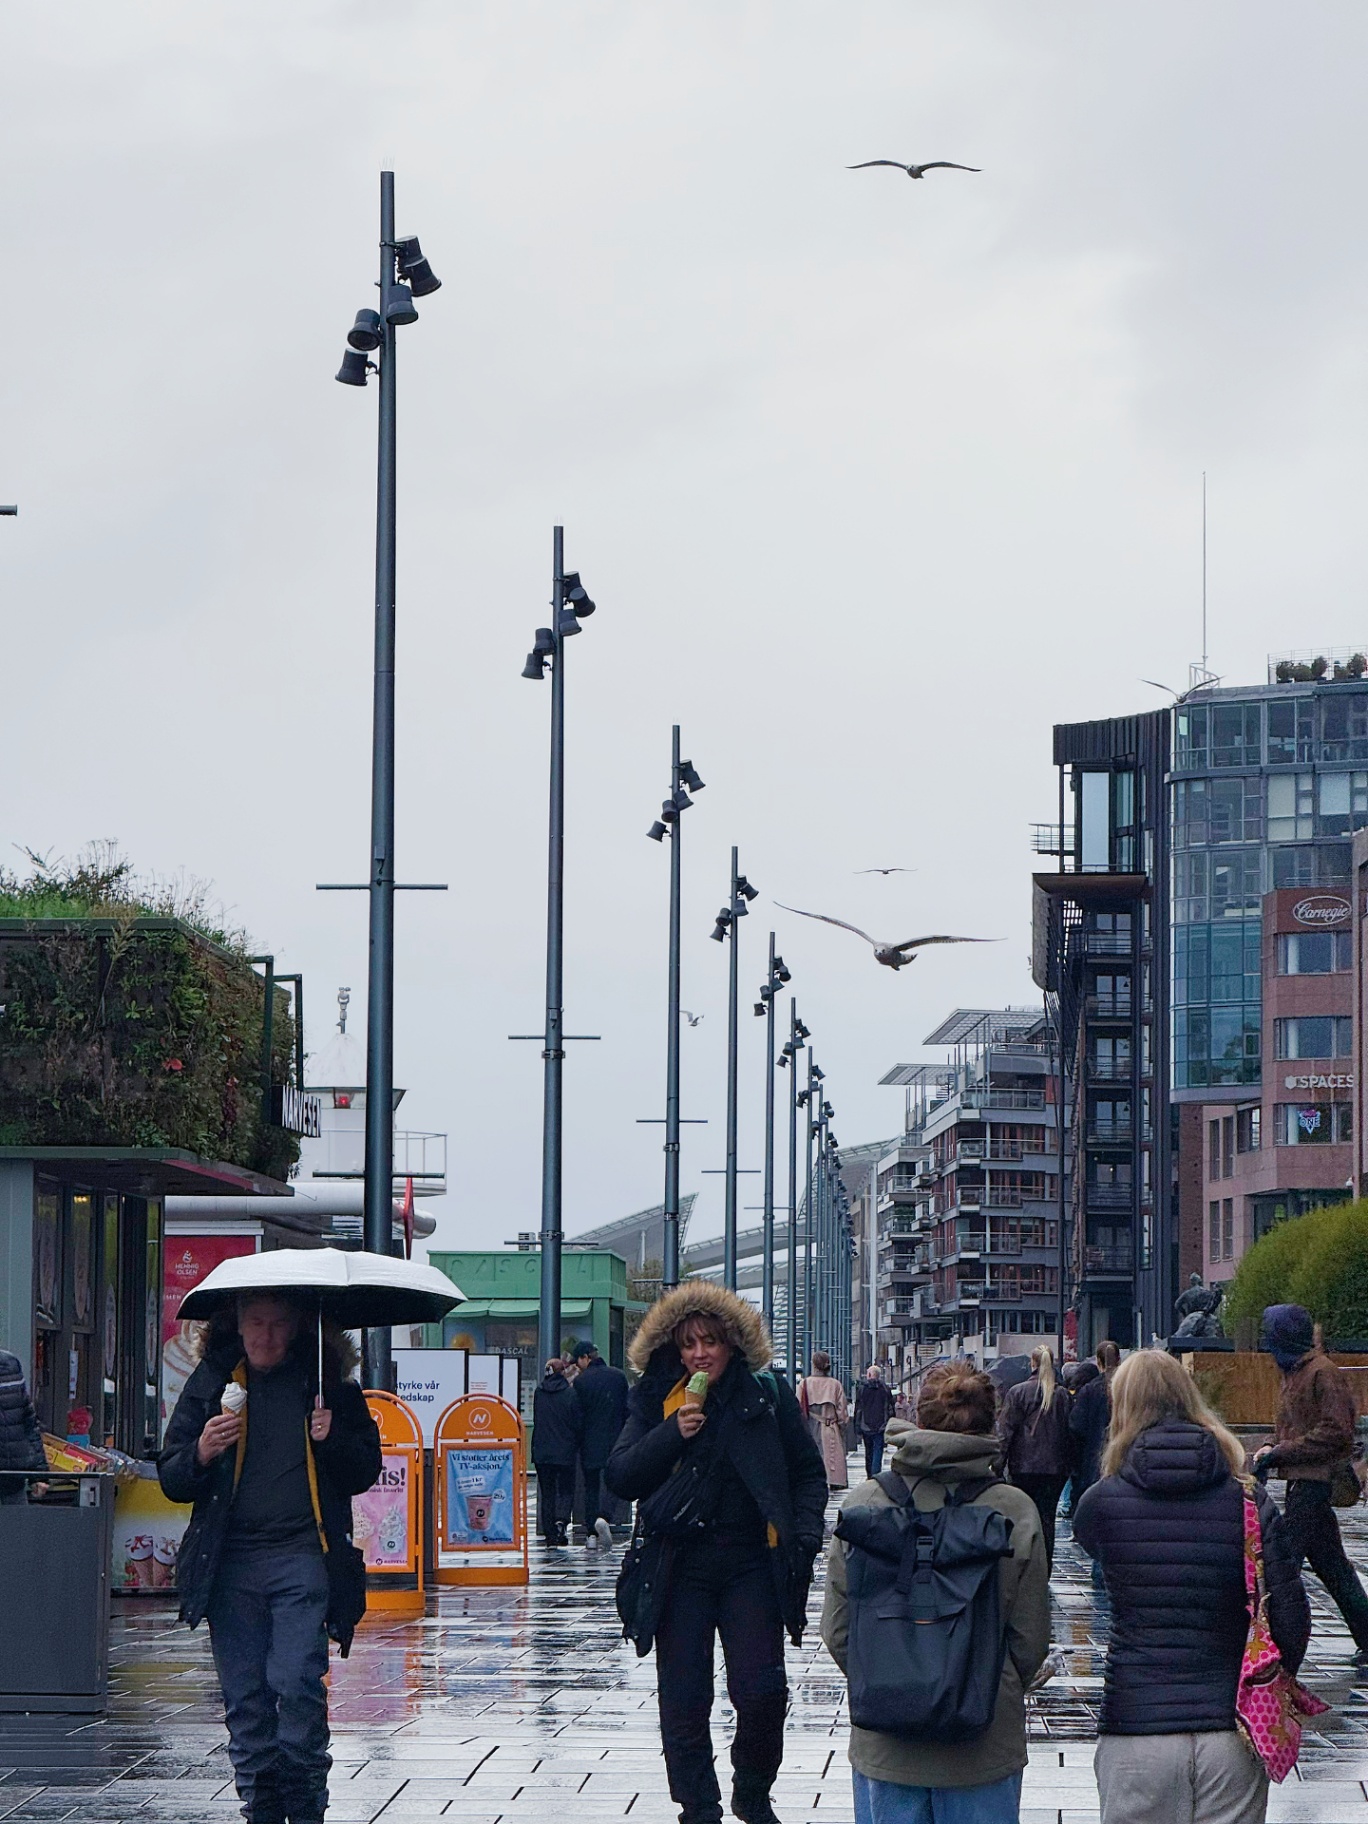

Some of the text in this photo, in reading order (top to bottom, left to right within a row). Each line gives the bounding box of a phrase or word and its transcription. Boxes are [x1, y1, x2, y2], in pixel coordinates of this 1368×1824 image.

[1297, 902, 1350, 922] Carnegie
[1299, 1073, 1355, 1089] SPACES
[424, 1380, 440, 1390] vår
[376, 1466, 406, 1486] is!
